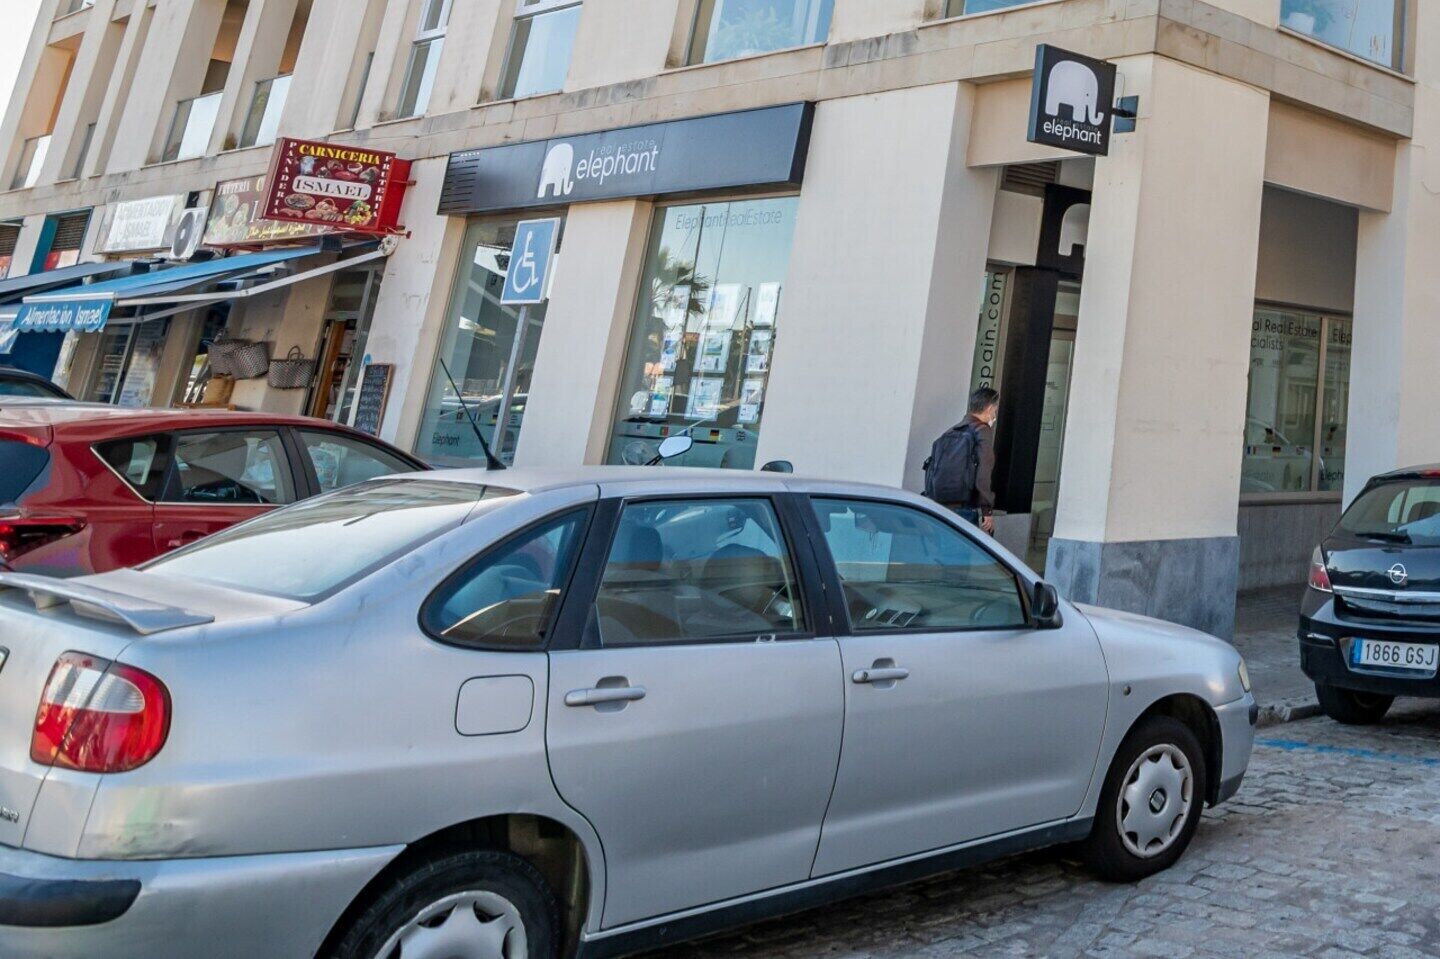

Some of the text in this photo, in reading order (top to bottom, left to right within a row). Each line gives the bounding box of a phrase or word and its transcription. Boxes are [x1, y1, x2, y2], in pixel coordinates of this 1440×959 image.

[1043, 118, 1102, 145] elephant
[299, 143, 381, 166] CARNICERIA
[595, 139, 656, 156] real estate
[576, 145, 659, 186] elephant
[272, 141, 298, 215] PANADERIA
[296, 179, 368, 198] ISMAEL
[74, 304, 104, 326] Ismael
[1265, 318, 1287, 335] Real
[1288, 321, 1318, 338] Estate
[1366, 643, 1435, 666] 1866 GSJ
